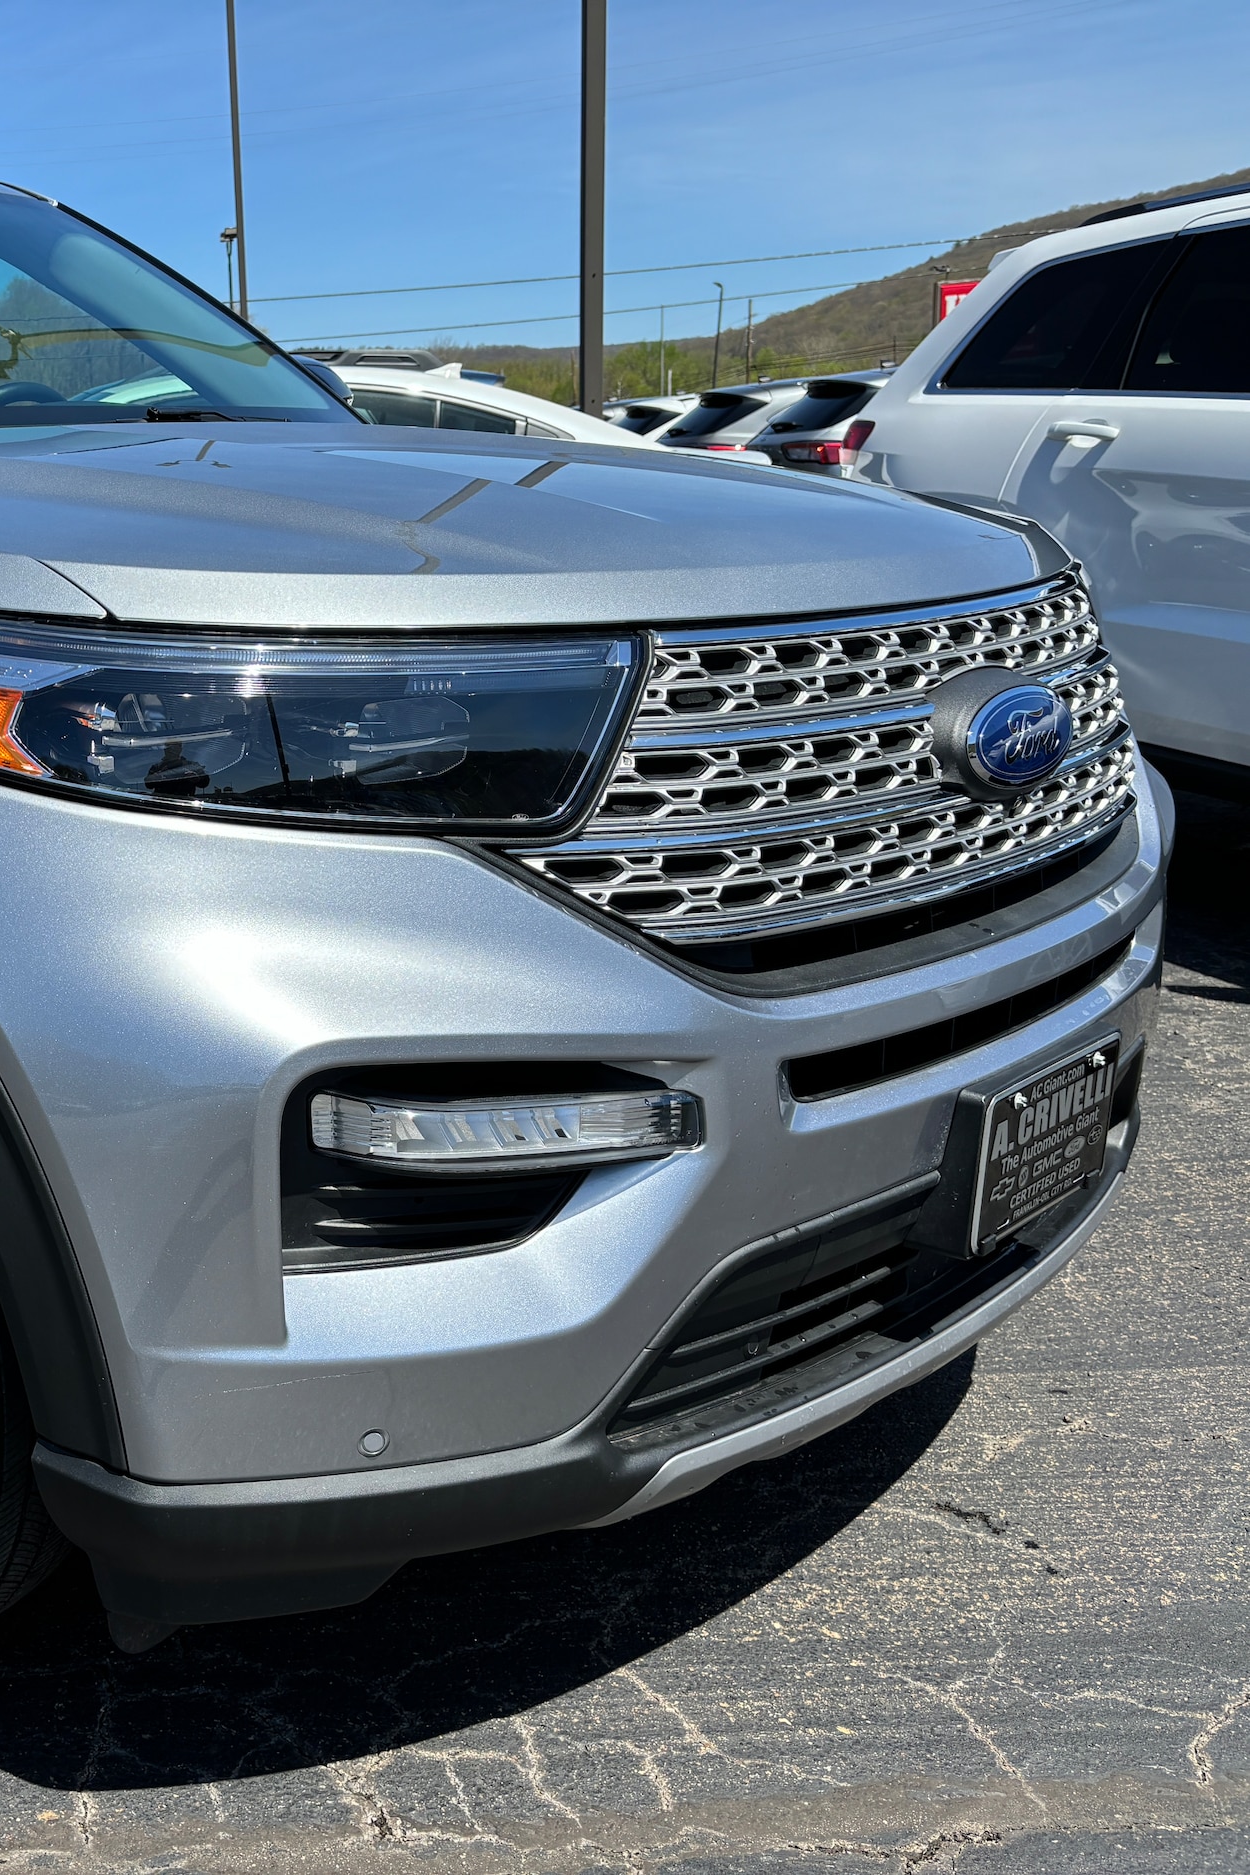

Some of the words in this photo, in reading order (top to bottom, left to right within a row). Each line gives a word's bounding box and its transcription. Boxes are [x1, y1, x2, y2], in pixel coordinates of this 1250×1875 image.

[1004, 706, 1061, 766] Ford
[990, 1119, 1015, 1161] A.
[1017, 1062, 1115, 1146] CRIVELLI
[1001, 1154, 1020, 1175] The
[1021, 1123, 1074, 1165] Automotive
[1075, 1106, 1100, 1132] Giant
[1009, 1171, 1057, 1209] CERTIFIED
[1057, 1157, 1081, 1180] USED
[1032, 1148, 1063, 1177] GMC
